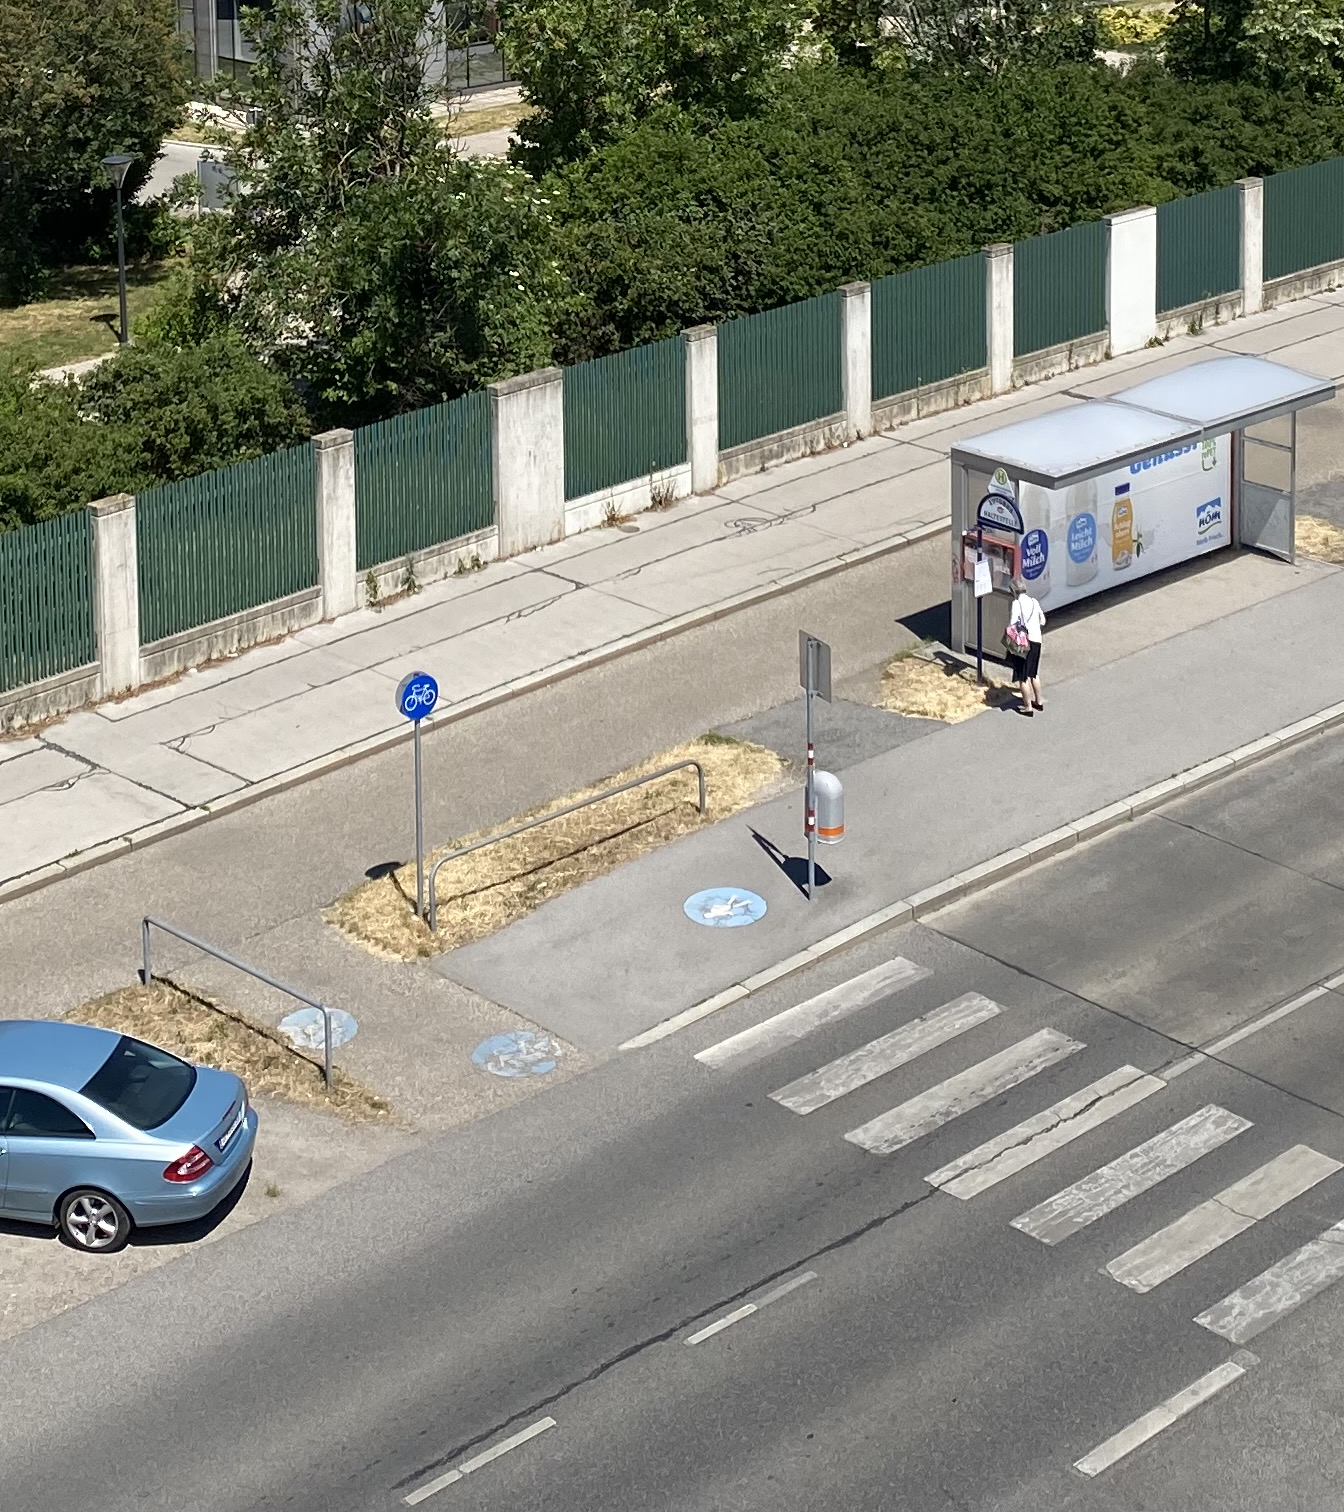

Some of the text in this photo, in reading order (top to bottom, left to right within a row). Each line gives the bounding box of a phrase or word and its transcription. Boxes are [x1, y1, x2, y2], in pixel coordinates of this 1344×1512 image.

[998, 470, 1005, 483] H
[1026, 543, 1042, 557] Voll
[1071, 535, 1093, 551] Milch
[1022, 552, 1045, 569] Milch
